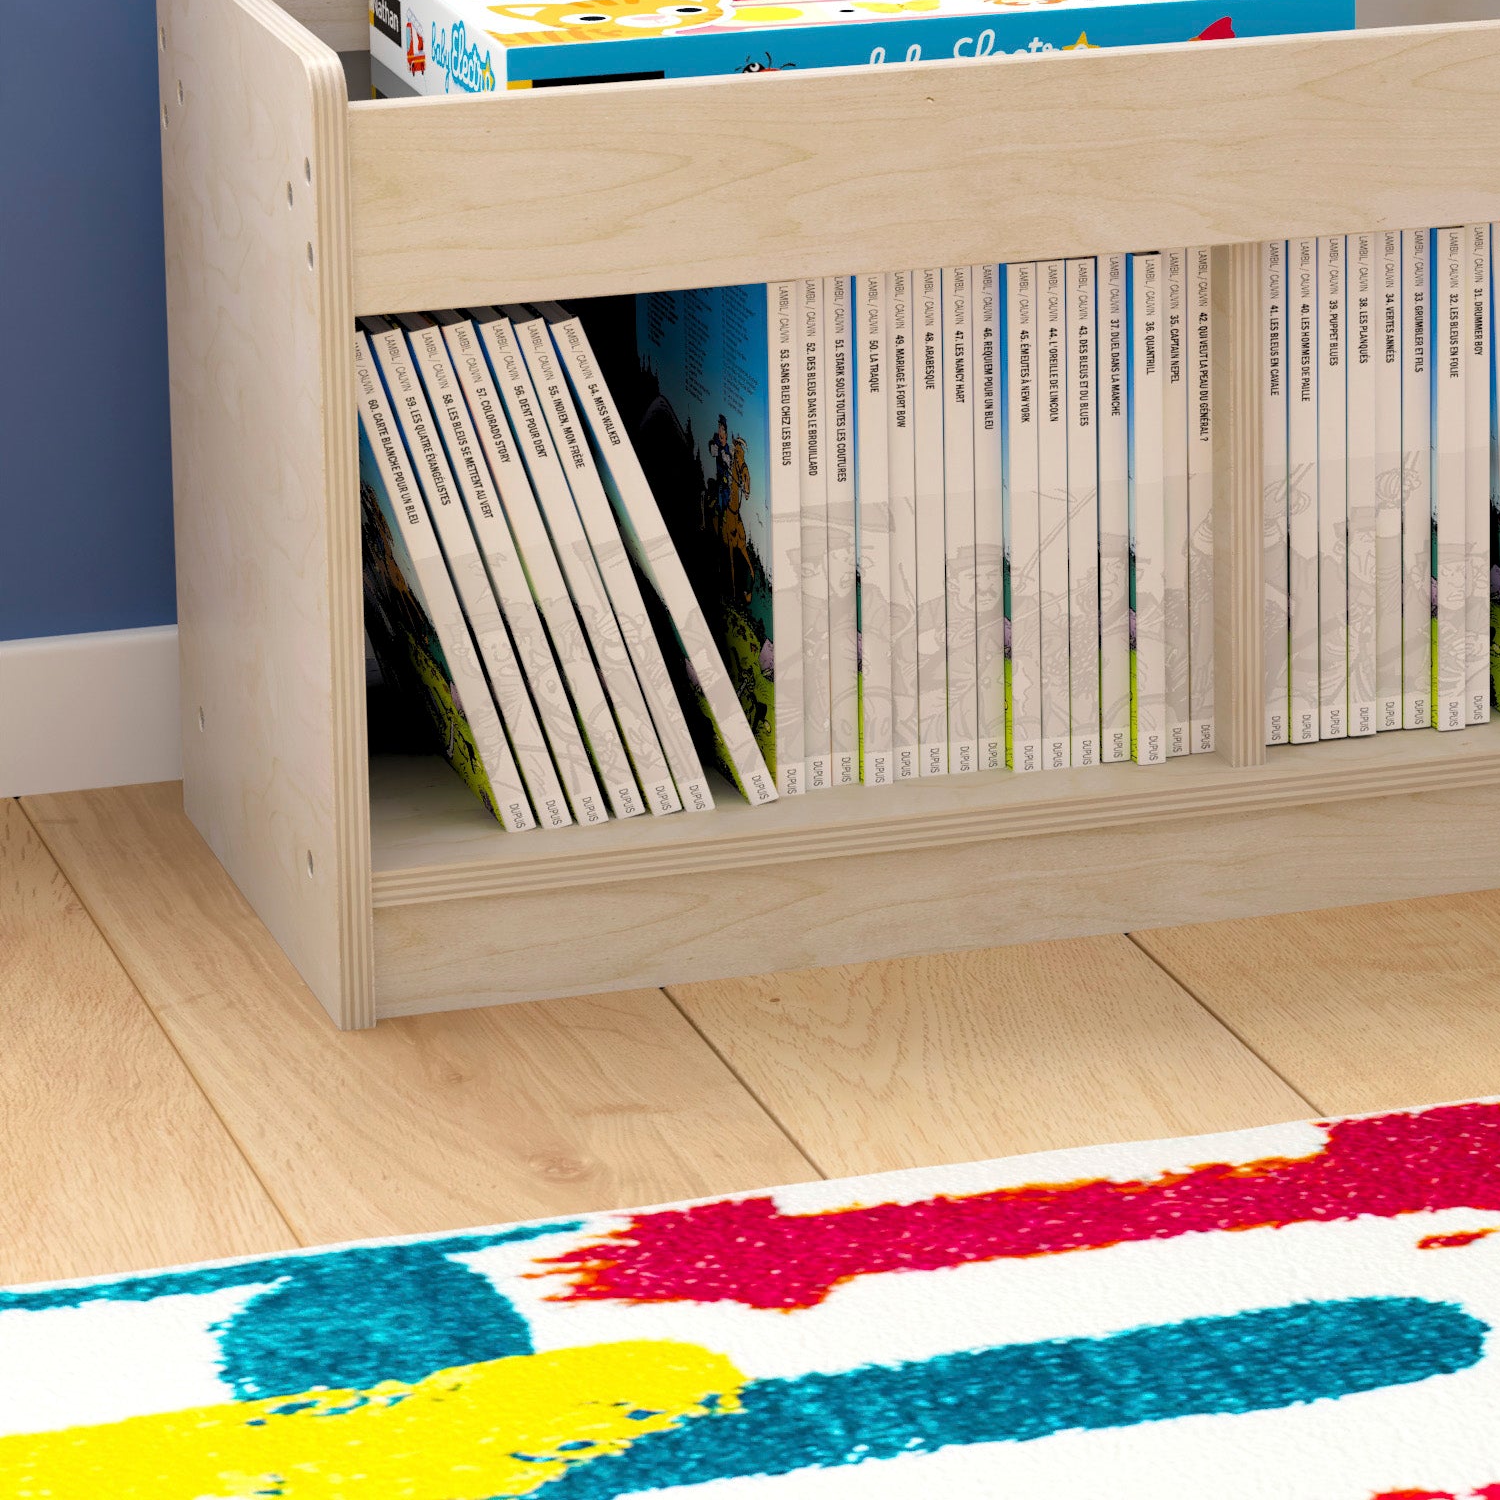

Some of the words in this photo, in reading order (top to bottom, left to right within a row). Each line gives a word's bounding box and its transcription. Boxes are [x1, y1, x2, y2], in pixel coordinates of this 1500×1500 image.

[1300, 241, 1310, 267] LAMBIL
[1169, 252, 1179, 278] LAMBIL
[954, 267, 964, 293] LAMBIL
[1300, 273, 1310, 298] CAUVIN
[1169, 284, 1180, 309] CAUVIN
[1358, 297, 1368, 310] 38.
[1449, 293, 1459, 306] 32.
[1473, 288, 1483, 299] 31.
[954, 299, 964, 325] CAUVIN
[1198, 312, 1208, 324] 42.
[1300, 303, 1310, 315] 40.
[1359, 310, 1368, 325] LES
[1449, 306, 1459, 320] LES
[1145, 321, 1155, 333] 36.
[1169, 314, 1179, 327] 35.
[1300, 317, 1310, 331] LES
[1474, 301, 1483, 339] DRUMMER
[924, 331, 934, 344] 48.
[955, 330, 964, 341] 47.
[1020, 329, 1029, 342] 45.
[1197, 325, 1208, 339] QUI
[1449, 321, 1459, 345] BLEUS
[834, 339, 844, 351] 51.
[954, 342, 964, 357] LES
[1170, 328, 1179, 359] CAPTAIN
[1199, 339, 1208, 358] VEUT
[1300, 331, 1310, 365] HOMMES
[1358, 325, 1370, 364] PLANQUÉS
[1449, 346, 1458, 356] EN
[1474, 340, 1483, 355] BOY
[780, 349, 790, 362] 53.
[835, 352, 845, 376] STARK
[1020, 343, 1031, 378] ÉMEUTES
[1144, 335, 1155, 375] QUANTRILL
[1199, 359, 1208, 369] LA
[780, 362, 790, 384] SANG
[923, 345, 935, 389] ARABESQUE
[955, 357, 964, 382] NANCY
[1170, 360, 1180, 384] NEPEL
[1301, 366, 1310, 377] DE
[1449, 357, 1459, 378] FOLIE
[835, 377, 845, 398] SOUS
[1199, 369, 1209, 389] PEAU
[1301, 377, 1310, 402] PAILLE
[475, 387, 487, 400] 57.
[548, 385, 559, 398] 55.
[780, 384, 790, 404] BLEU
[955, 384, 965, 403] HART
[1020, 385, 1030, 402] NEW
[1199, 390, 1208, 401] DU
[367, 399, 379, 413] 60.
[405, 396, 417, 409] 59.
[553, 398, 569, 426] INDIEN,
[836, 398, 846, 427] TOUTES
[1020, 402, 1030, 423] YORK
[372, 412, 389, 437] CARTE
[410, 409, 423, 424] LES
[480, 400, 502, 440] COLORADO
[587, 383, 599, 397] 54.
[593, 396, 609, 416] MISS
[601, 415, 621, 446] WALKER
[781, 405, 791, 426] CHEZ
[1199, 402, 1210, 435] GÉNÉRAL
[414, 424, 433, 453] QUATRE
[562, 426, 576, 445] MON
[781, 426, 791, 440] LES
[836, 428, 846, 442] LES
[381, 436, 401, 471] BLANCHE
[494, 440, 511, 463] STORY
[569, 444, 585, 469] FRÈRE
[781, 441, 791, 466] BLEUS
[836, 442, 847, 482] COUTURES
[393, 471, 408, 493] POUR
[425, 452, 451, 506] ÉVANGÉLISTES
[400, 492, 412, 504] UN
[405, 504, 419, 524] BLEU
[1448, 702, 1458, 727] DUPUIS
[1200, 725, 1210, 750] DUPUIS
[1302, 715, 1312, 739] DUPUIS
[929, 748, 940, 773] DUPUIS
[1024, 746, 1034, 771] DUPUIS
[787, 769, 797, 794] DUPUIS
[508, 804, 525, 828] DUPUIS
